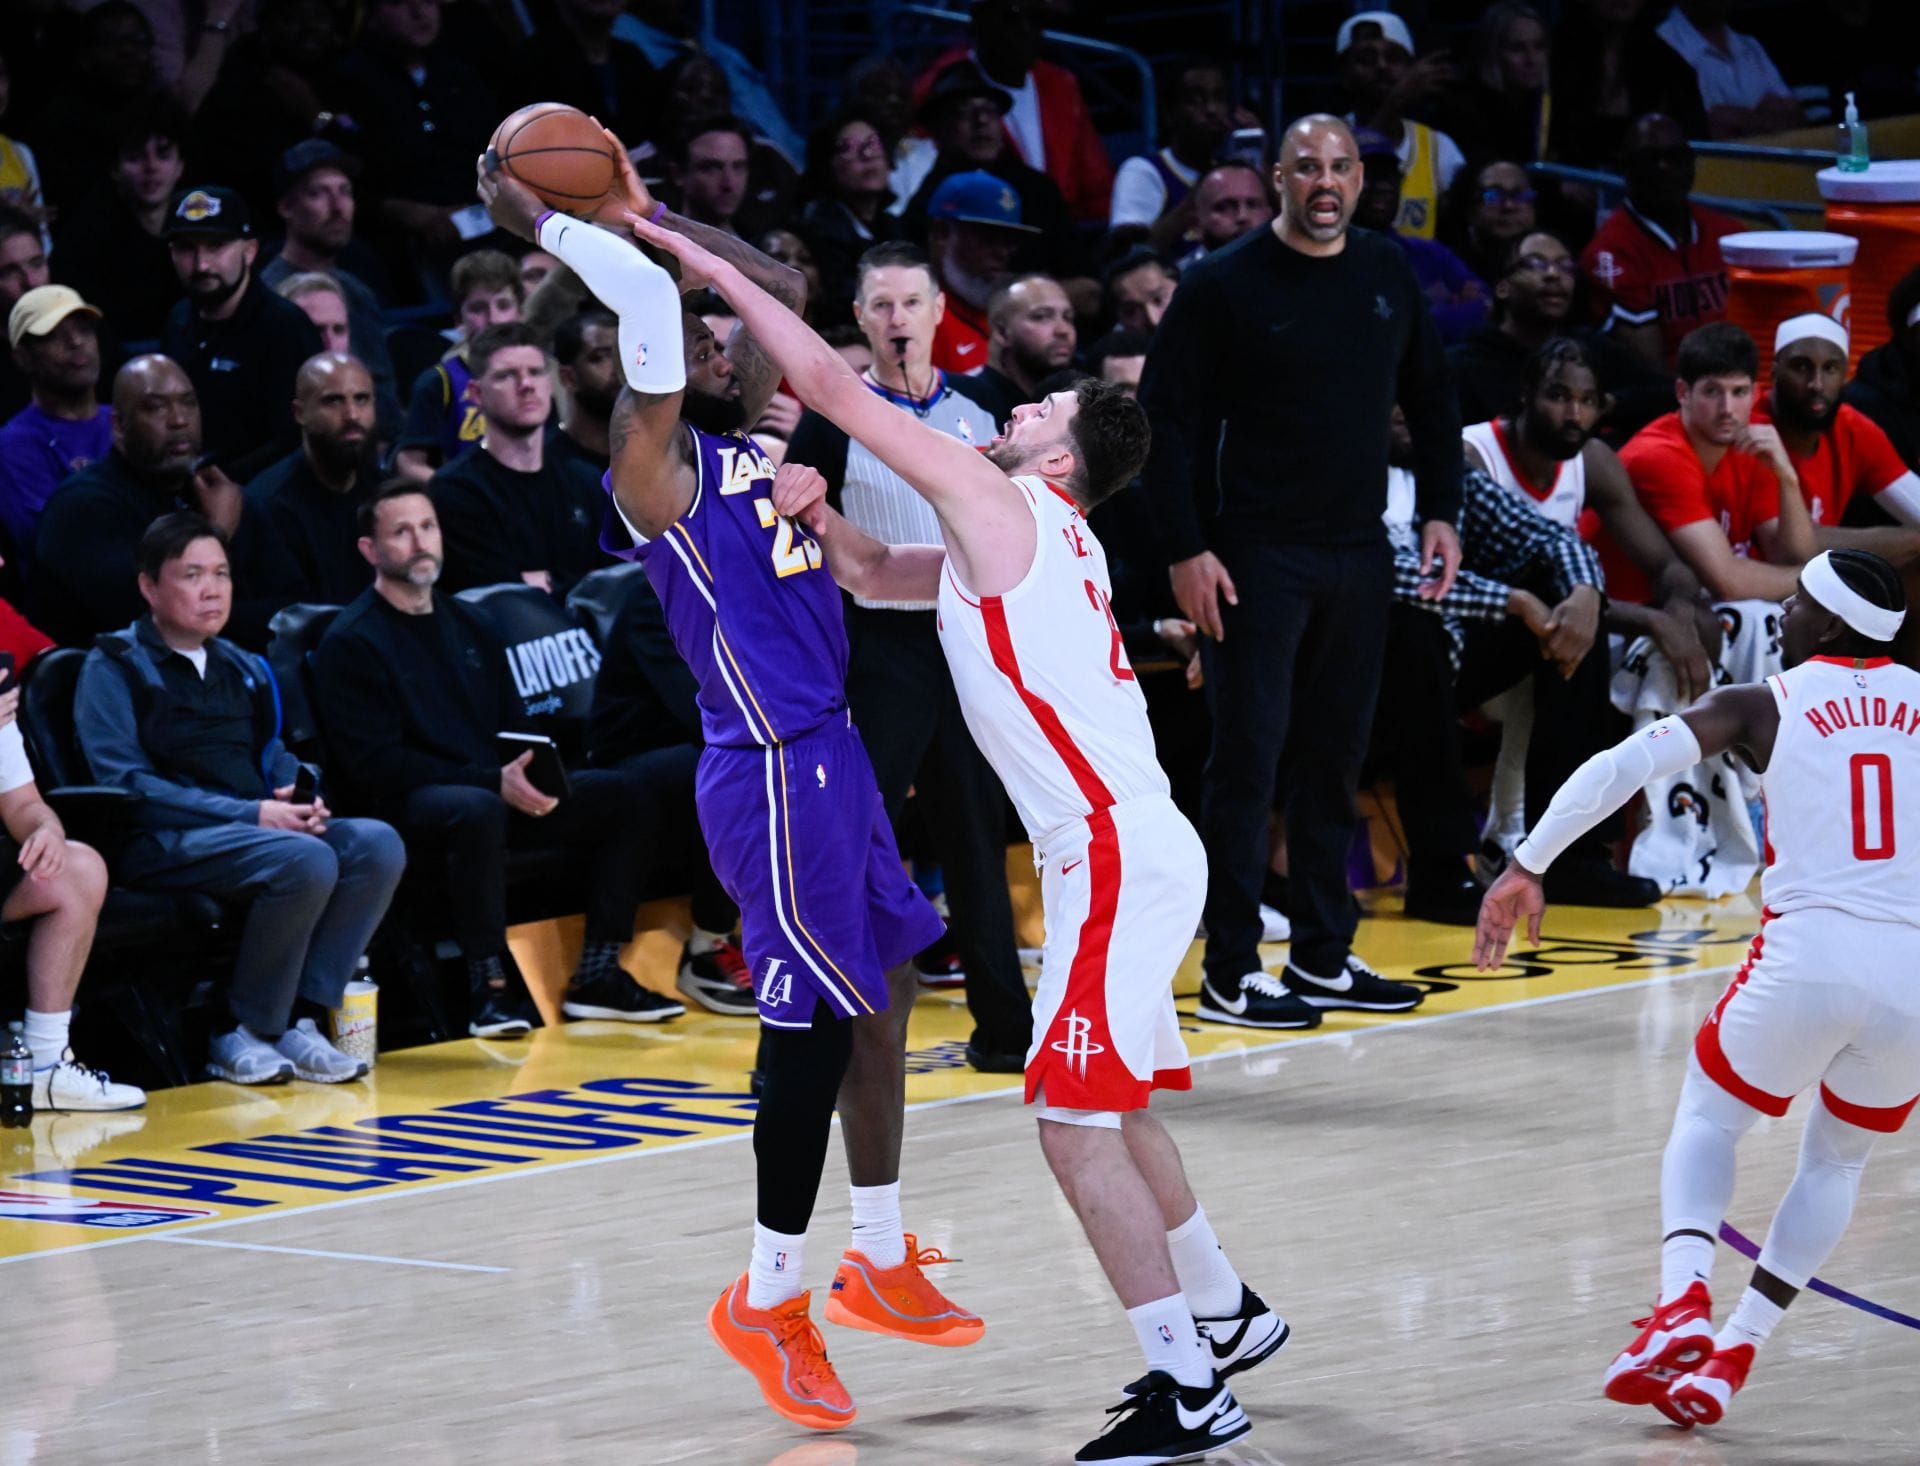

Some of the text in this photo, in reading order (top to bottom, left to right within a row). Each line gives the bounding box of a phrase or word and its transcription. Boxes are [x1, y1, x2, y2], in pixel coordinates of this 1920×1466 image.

[505, 626, 602, 698] LAYOFFS
[1804, 696, 1920, 738] HOLIDAY
[1850, 753, 1896, 861] 0
[1388, 929, 1757, 995] oogle
